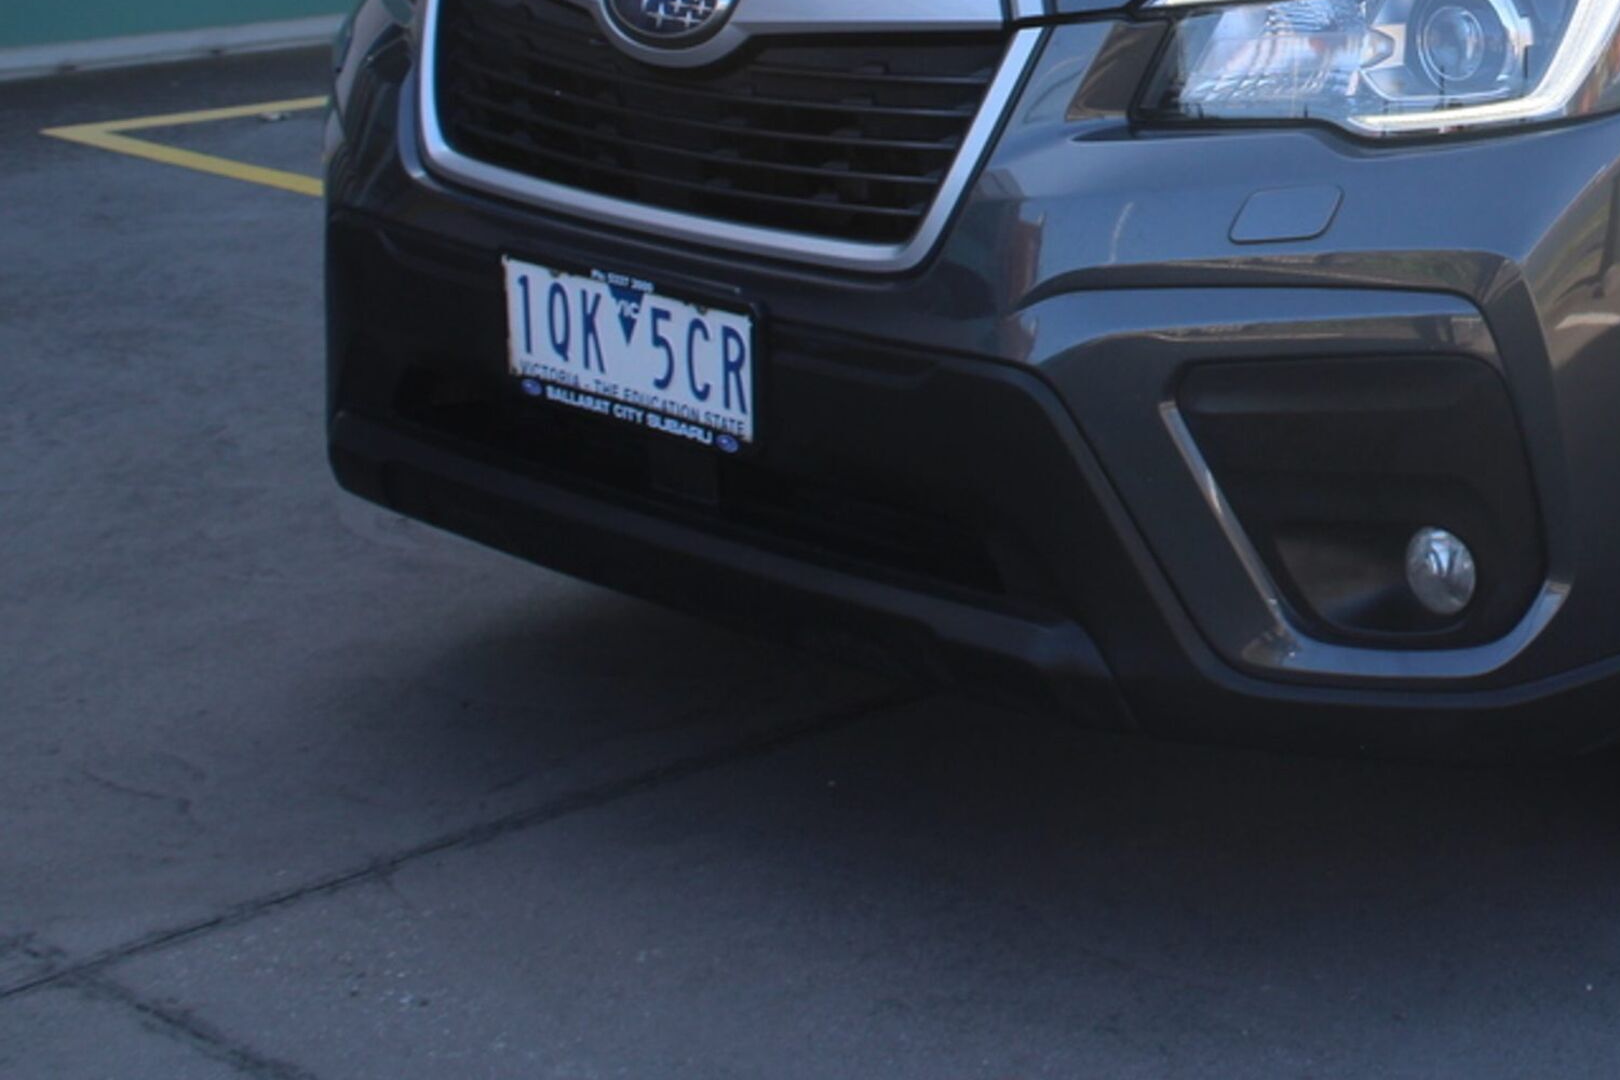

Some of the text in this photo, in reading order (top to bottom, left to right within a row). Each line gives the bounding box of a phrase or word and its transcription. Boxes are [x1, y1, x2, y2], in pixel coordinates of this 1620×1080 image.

[617, 299, 641, 318] VIC
[518, 274, 749, 416] 1QK 5CR
[593, 378, 620, 397] THE
[623, 386, 701, 420] EDUCATION
[703, 410, 746, 435] STATE
[612, 402, 645, 424] CITY
[645, 413, 714, 445] SUBARU
